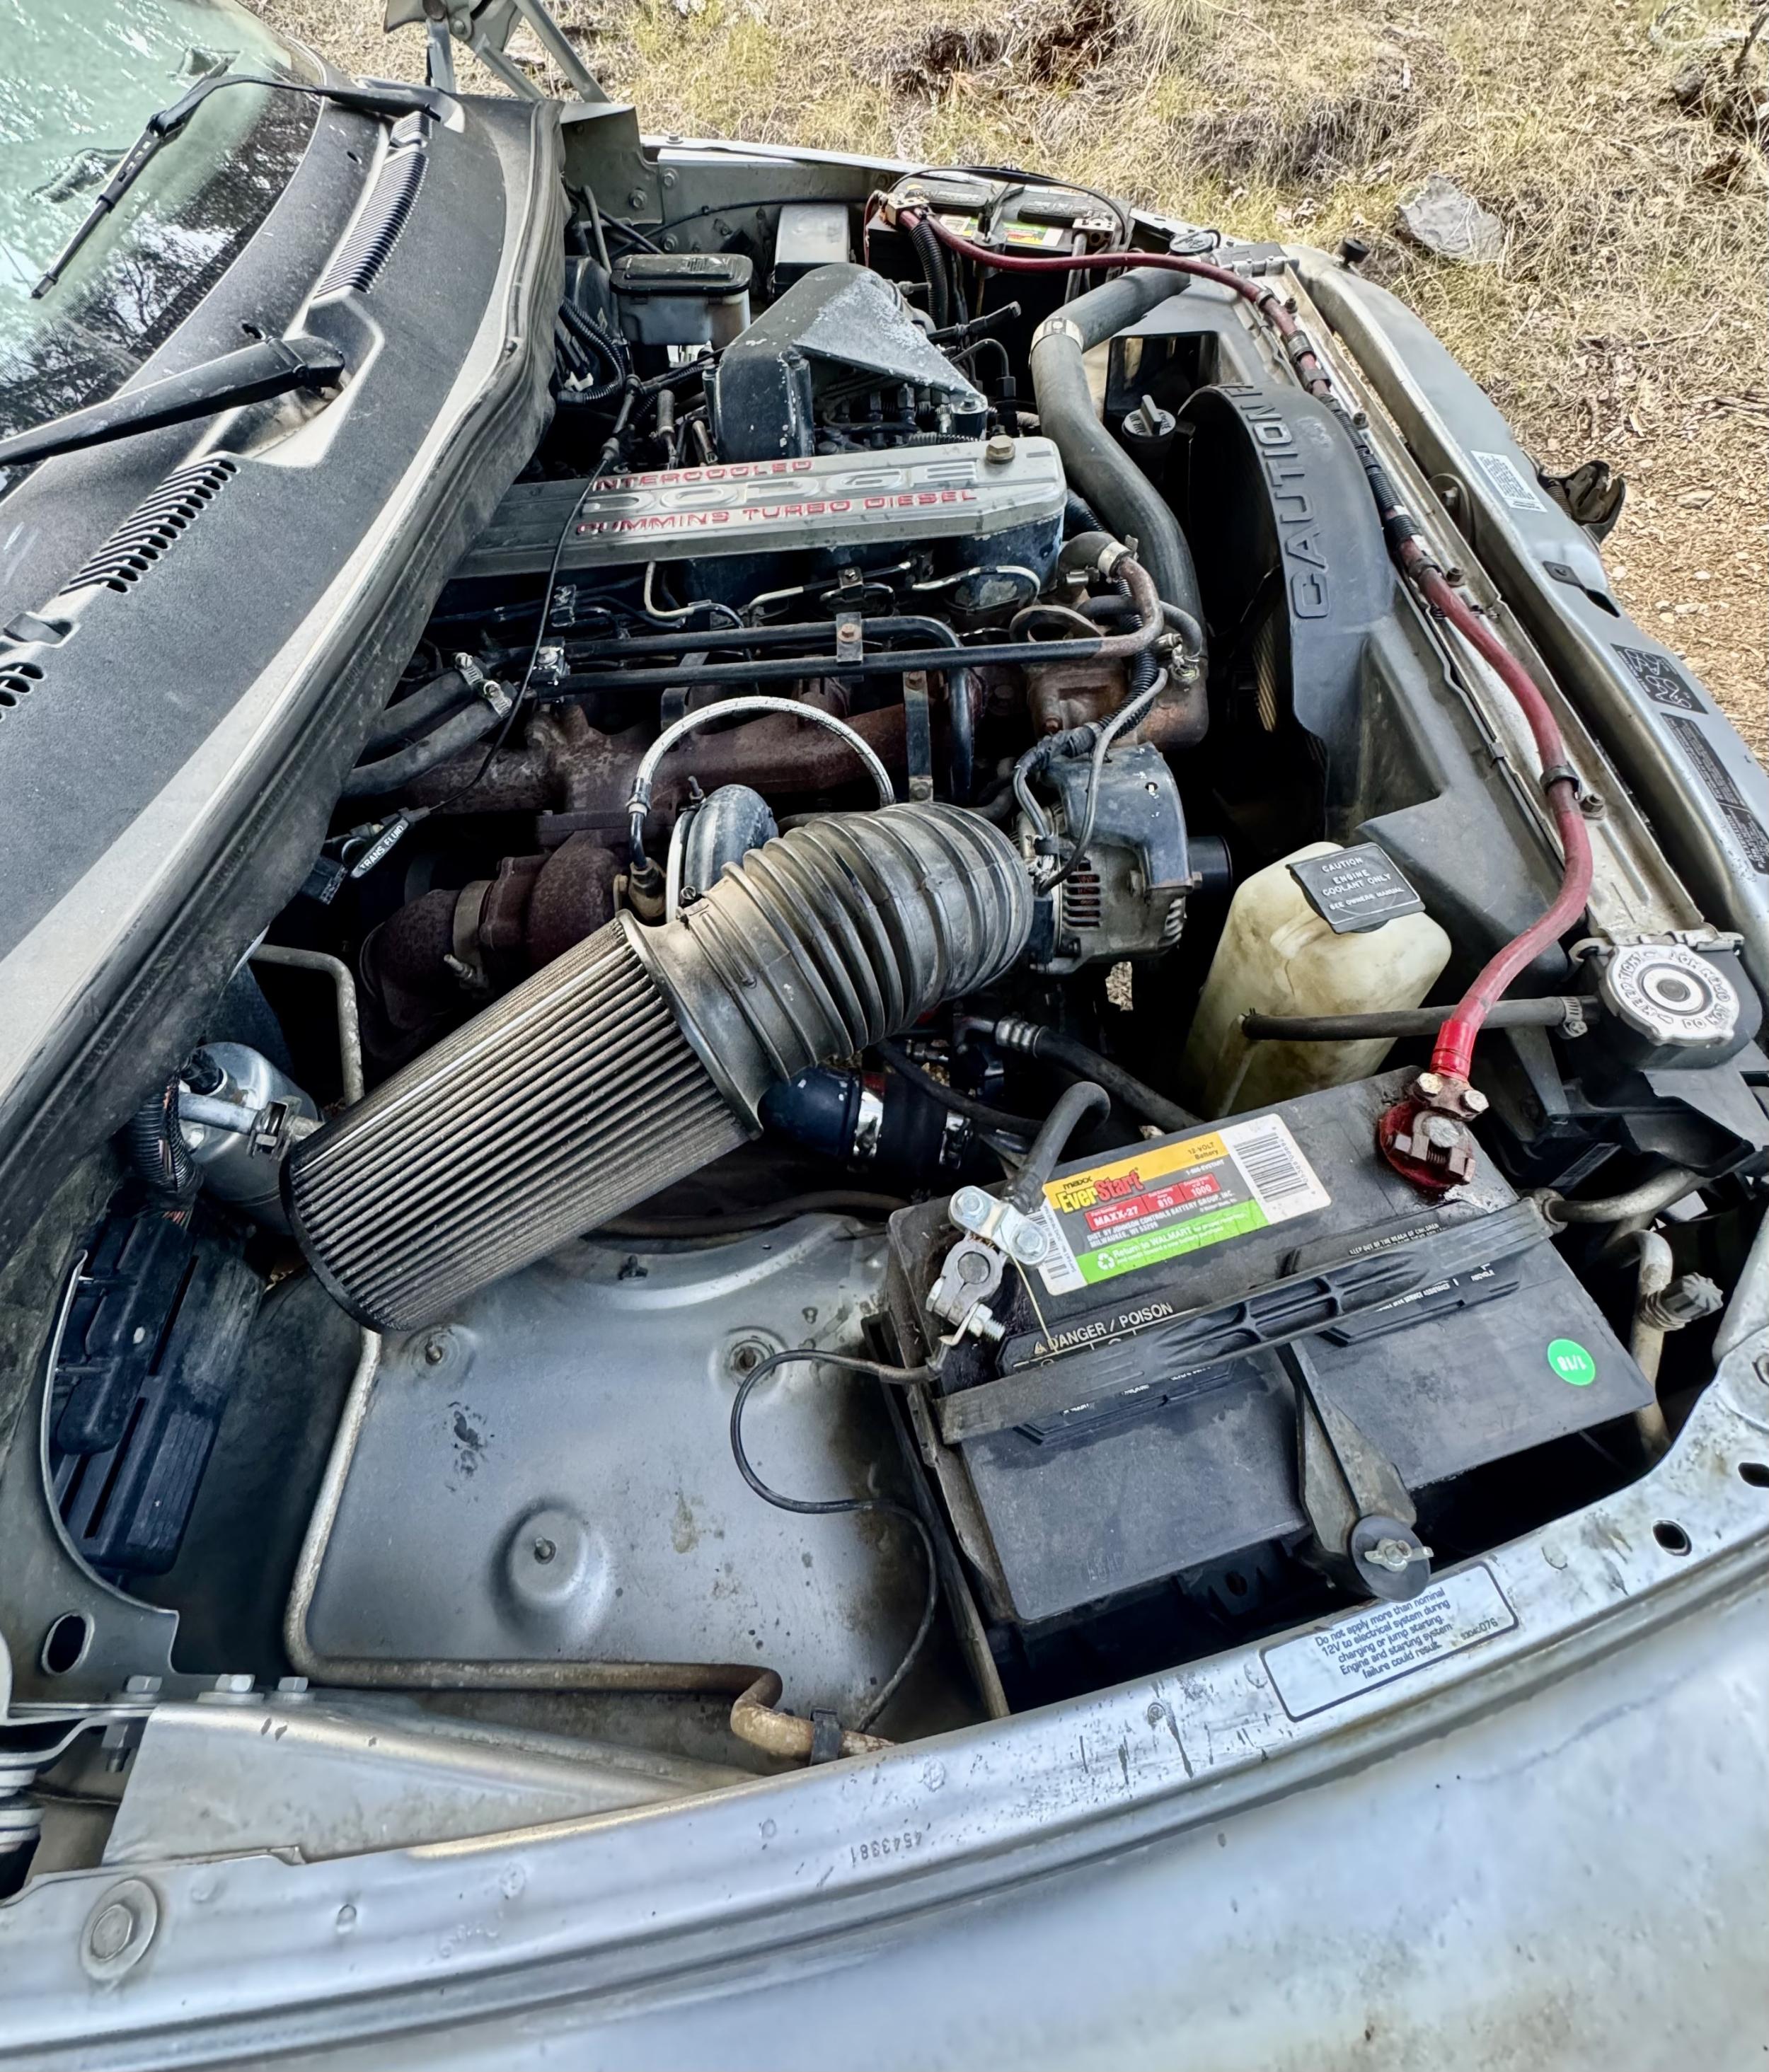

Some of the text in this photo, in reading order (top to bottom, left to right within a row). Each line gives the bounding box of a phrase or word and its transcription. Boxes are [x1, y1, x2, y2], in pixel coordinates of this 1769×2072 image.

[582, 460, 978, 514] DODGE
[592, 460, 812, 492] INTERCOOLED
[576, 490, 978, 536] CUMMINS TURBO DIESEL
[1240, 402, 1330, 619] CAUTION
[359, 824, 405, 871] TRANS FLUID
[1321, 857, 1364, 873] CAUTION
[1332, 869, 1370, 884] ENGINE
[1322, 873, 1392, 896] COOLANT ONLY
[1329, 901, 1344, 910] SEE
[1056, 1169, 1145, 1215] EverStart
[1063, 1176, 1093, 1190] maxx
[1191, 1183, 1212, 1197] 1000
[1093, 1205, 1139, 1227] MAXX-27
[1139, 1210, 1172, 1224] CONTROLS
[1170, 1200, 1198, 1213] BATTERY
[1112, 1245, 1141, 1258] Return
[1141, 1242, 1151, 1250] to
[1149, 1227, 1193, 1246] WALMART
[1047, 1321, 1107, 1350] DANGER
[1119, 1302, 1174, 1329] POISON
[1315, 1587, 1446, 1647] Do not apply more than nominal
[1322, 1599, 1451, 1656] 12V to electrical system during
[1338, 1615, 1444, 1664] charging or jump starting.
[1339, 1623, 1453, 1675] Engine and starting system
[1362, 1662, 1390, 1679] failure
[1391, 1650, 1414, 1667] could
